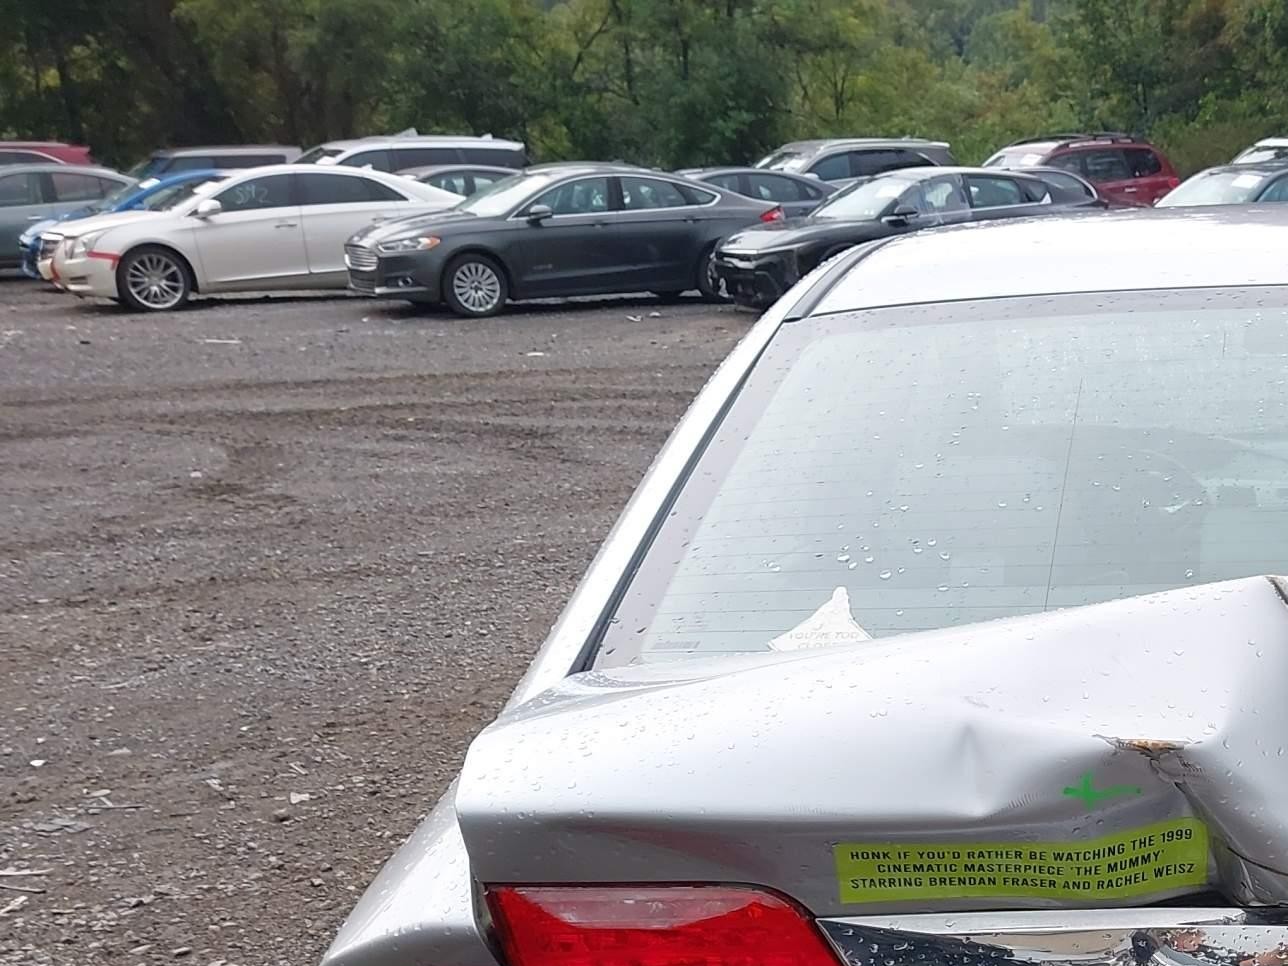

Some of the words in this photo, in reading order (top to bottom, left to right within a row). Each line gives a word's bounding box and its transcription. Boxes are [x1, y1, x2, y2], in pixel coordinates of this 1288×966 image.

[850, 851, 891, 861] HONK
[897, 851, 910, 860] IF
[917, 851, 961, 860] YOU'D
[967, 850, 1023, 860] RATHER
[1029, 851, 1047, 861] BE
[1053, 843, 1126, 862] WATCHING
[1130, 835, 1155, 850] THE
[1160, 828, 1193, 843] 1999
[877, 863, 958, 873] CINEMATIC
[964, 863, 1065, 876] MASTERPIECE
[1070, 864, 1101, 876] 'THE
[1107, 849, 1165, 873] MUMMY'
[850, 877, 923, 889] STARRING
[929, 876, 997, 887] BRENDAN
[1003, 877, 1057, 889] FRASER
[1062, 880, 1091, 890] AND
[1097, 871, 1149, 890] RACHEL
[1154, 863, 1195, 878] WEISZ
